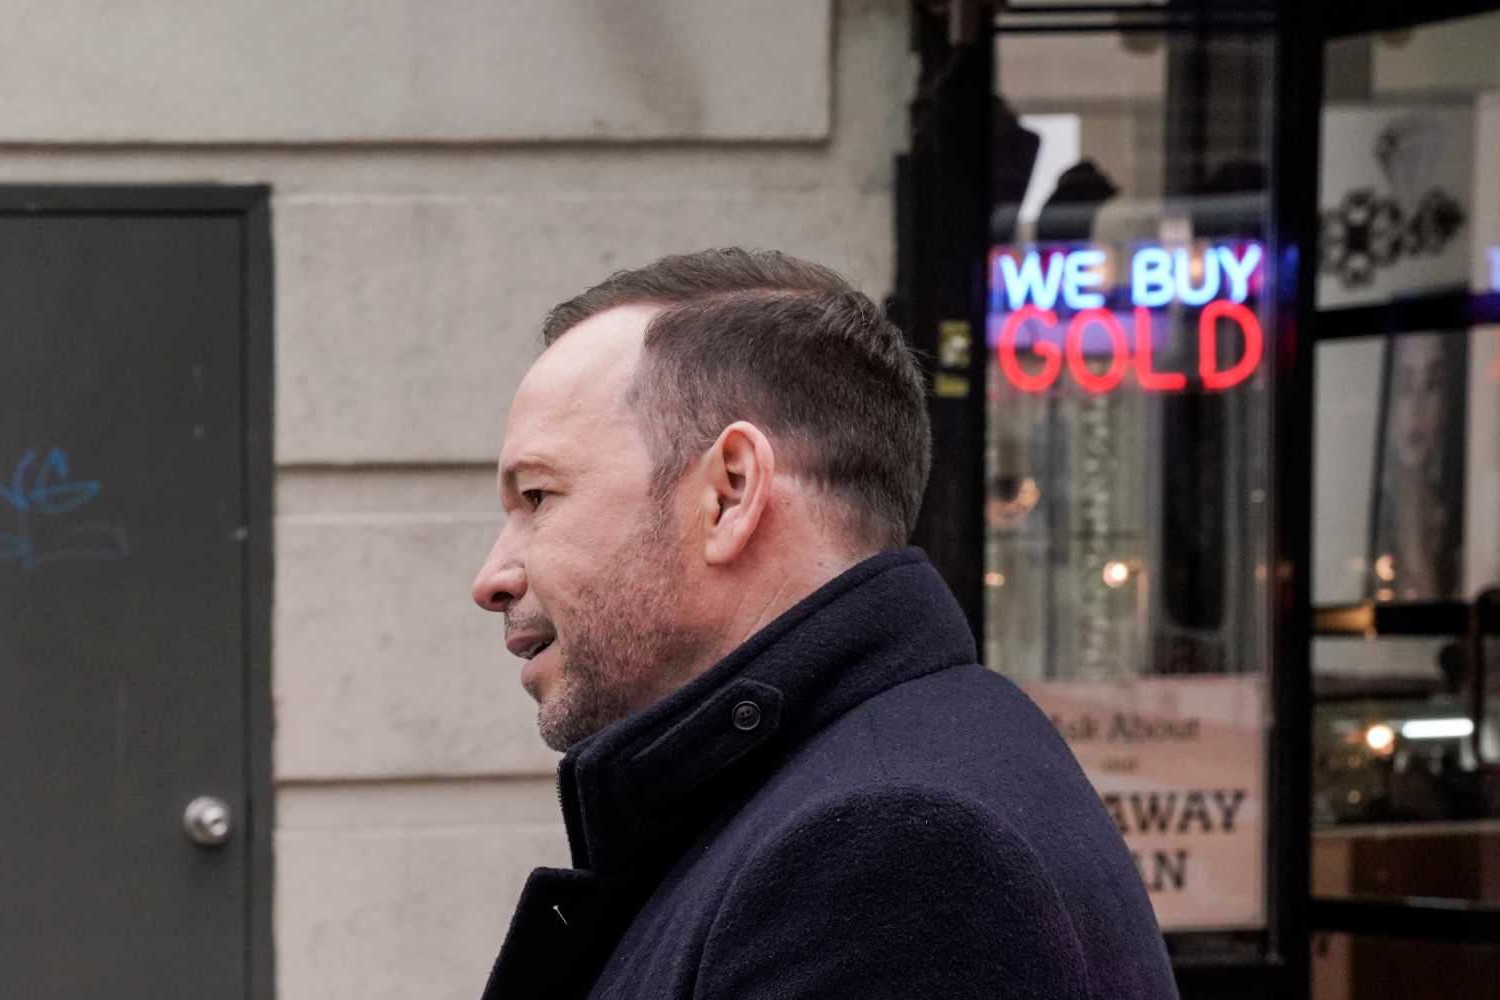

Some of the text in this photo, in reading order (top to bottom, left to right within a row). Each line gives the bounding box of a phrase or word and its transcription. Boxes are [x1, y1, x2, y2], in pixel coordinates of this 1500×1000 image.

[999, 244, 1264, 311] WE BUY
[998, 300, 1264, 393] GOLD
[1107, 711, 1200, 743] About
